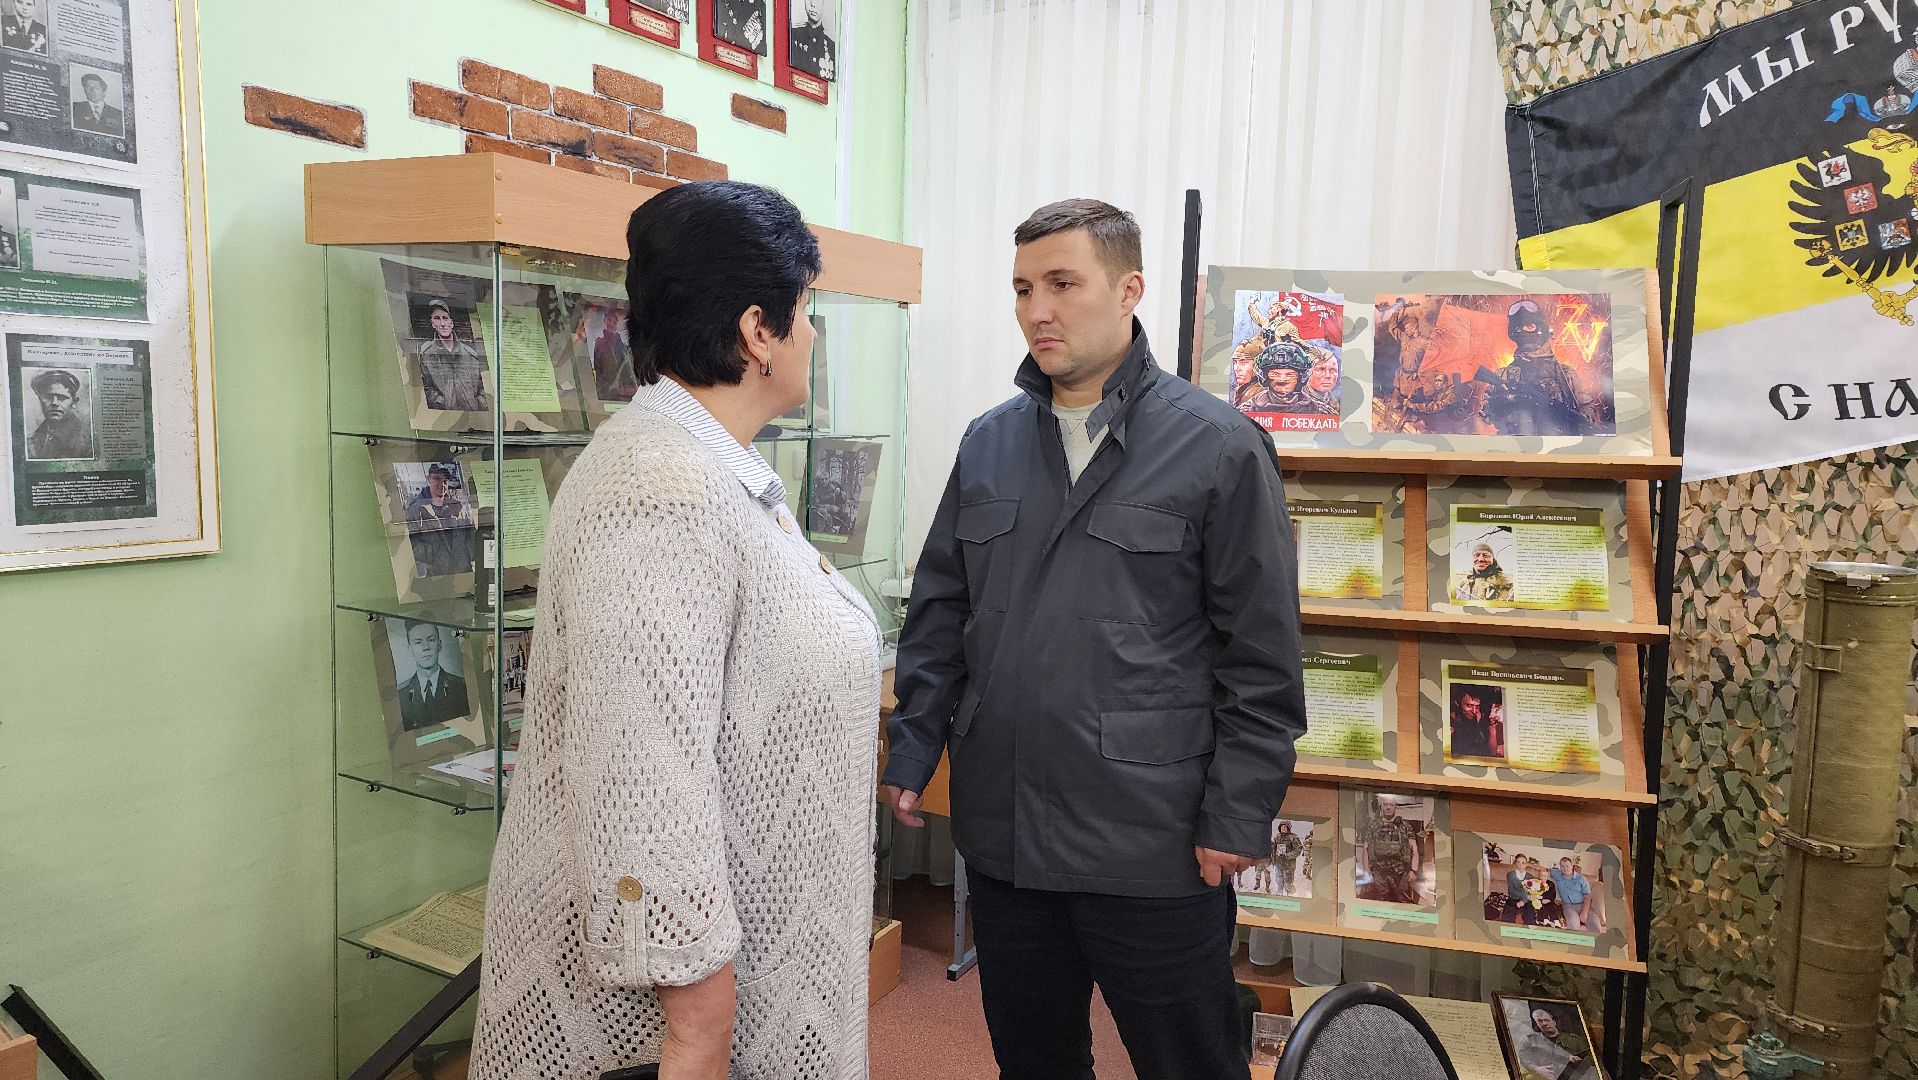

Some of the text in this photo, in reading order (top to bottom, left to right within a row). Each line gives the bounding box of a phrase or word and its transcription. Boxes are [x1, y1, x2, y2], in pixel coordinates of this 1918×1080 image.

[1699, 0, 1918, 128] МЫ РУ
[1768, 383, 1812, 420] С
[1282, 417, 1337, 429] ПОБЕЖДАТЬ
[1512, 513, 1534, 521] Юрий
[1535, 514, 1577, 522] Алексеевич
[1313, 656, 1351, 666] Сергеевич
[1471, 669, 1489, 677] Иван
[1490, 670, 1533, 680] Васильевич
